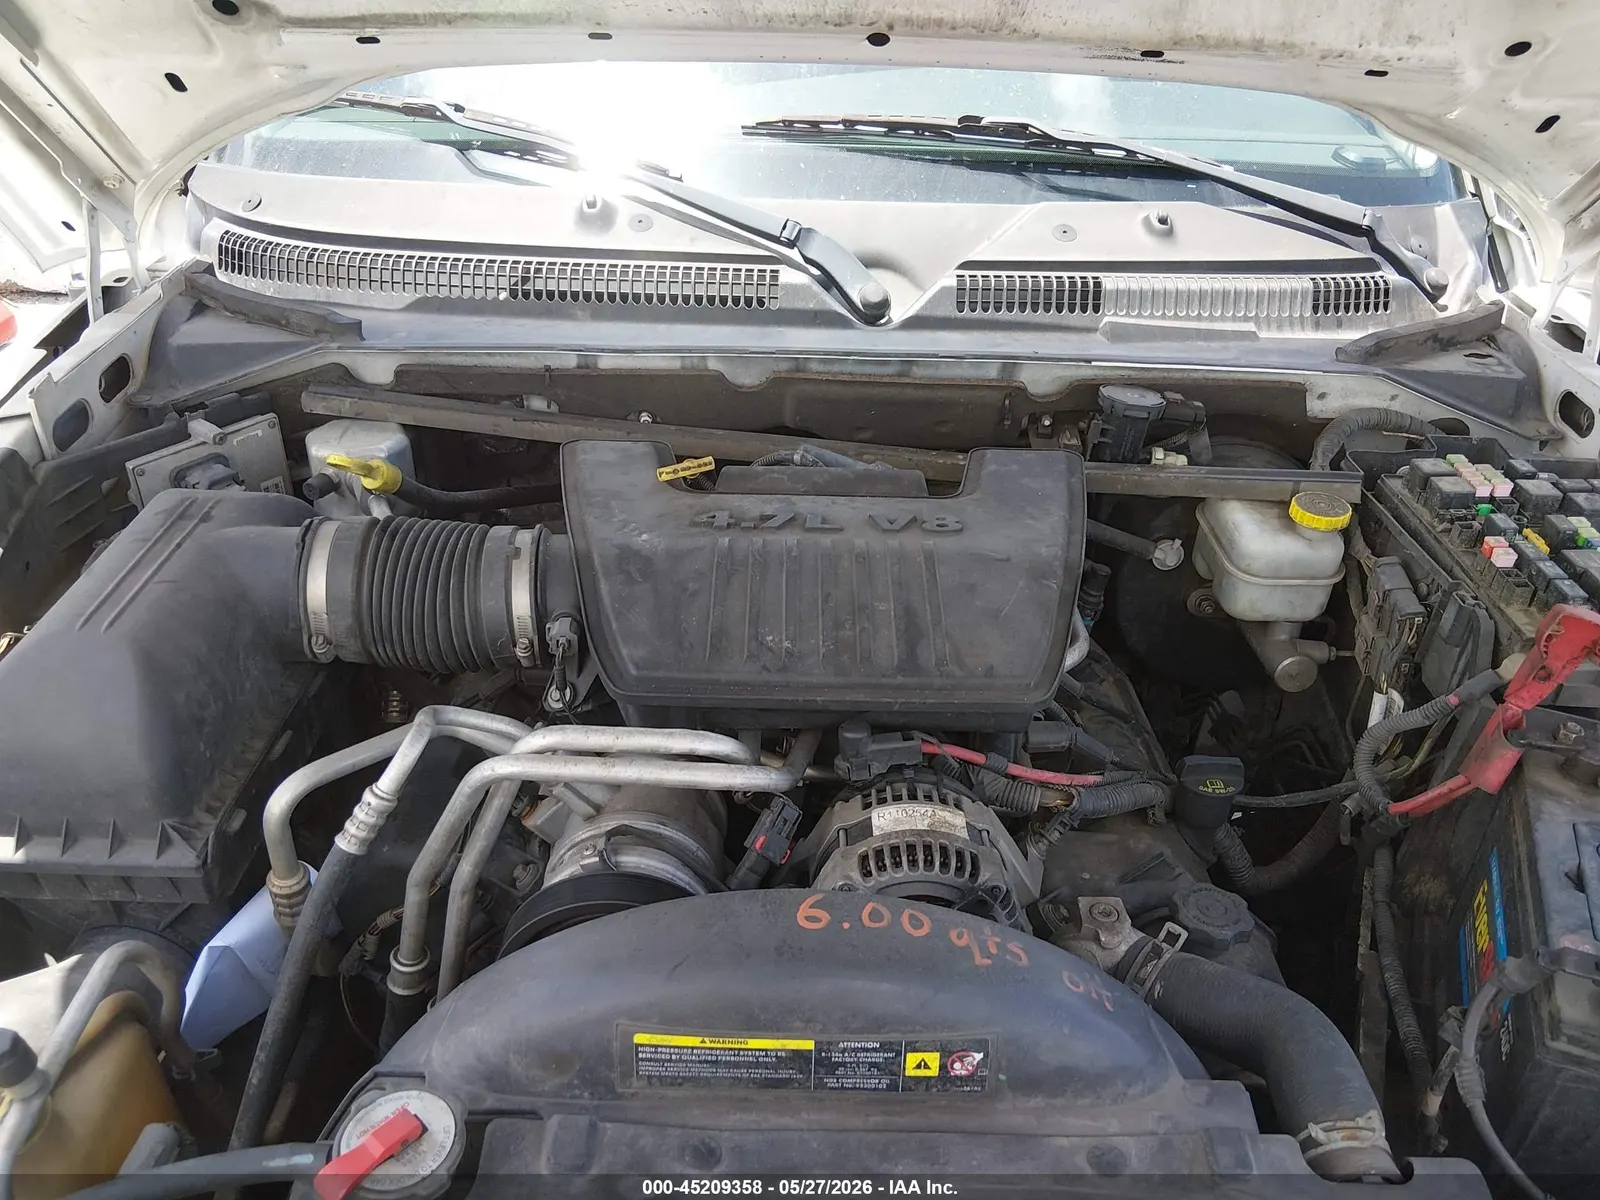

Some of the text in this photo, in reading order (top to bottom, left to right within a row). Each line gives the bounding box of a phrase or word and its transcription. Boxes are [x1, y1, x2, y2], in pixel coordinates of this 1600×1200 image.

[694, 509, 963, 533] 4.7L V8
[795, 892, 932, 938] 6.00
[708, 1038, 749, 1046] WARNING
[838, 1041, 881, 1049] ATTENTION
[638, 1046, 693, 1055] HIGH-PRESSURE
[693, 1048, 739, 1057] REFRIGERANT
[638, 1052, 671, 1060] SERVICED
[355, 1127, 371, 1140] HOT
[442, 1124, 451, 1141] LIFT
[431, 1141, 446, 1164] LEVER
[420, 1161, 432, 1174] TO
